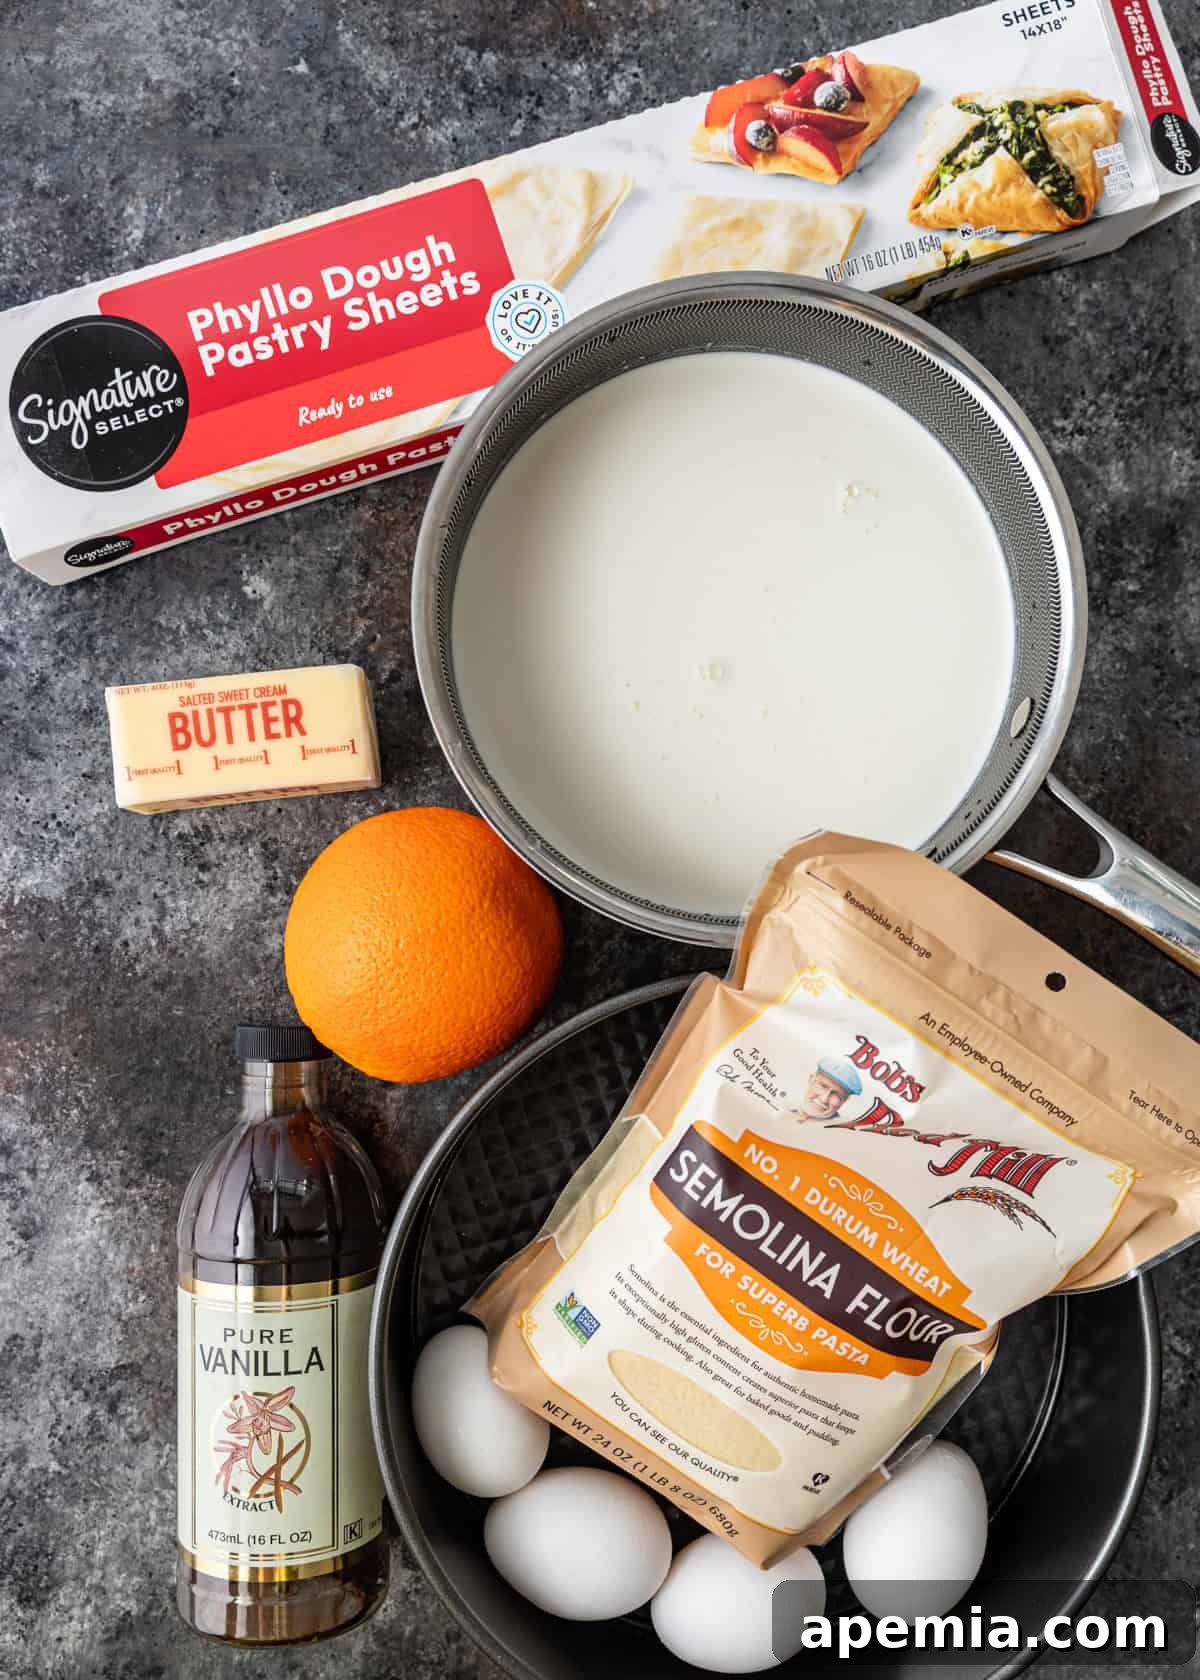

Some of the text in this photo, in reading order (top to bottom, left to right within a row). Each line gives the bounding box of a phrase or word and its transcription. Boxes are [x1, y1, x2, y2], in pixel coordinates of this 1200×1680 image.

[1002, 0, 1075, 27] SHEETS
[1123, 5, 1162, 107] Phyllo Dough
[1150, 55, 1172, 106] Pastry
[187, 235, 456, 342] Phyllo Dough
[824, 262, 844, 281] NET
[844, 257, 860, 277] WT
[861, 253, 874, 271] 16
[875, 249, 888, 267] OZ
[889, 245, 899, 265] (1
[900, 240, 918, 260] LB)
[197, 269, 480, 377] Pastry Sheets
[498, 288, 552, 319] LOVE IT
[501, 328, 513, 343] OR
[18, 364, 177, 450] Signature
[298, 385, 393, 427] Ready to use
[162, 499, 264, 535] Phyllo
[272, 462, 378, 501] Dough
[167, 698, 307, 751] BUTTER
[179, 684, 288, 707] SALTED SWEET CREAM
[843, 890, 932, 959] Resealable Package
[733, 1048, 755, 1071] Good
[749, 1047, 776, 1079] To Your
[846, 1034, 926, 1104] Bob's
[918, 1012, 1079, 1127] An Employee-Owned Company
[1128, 1089, 1150, 1109] Tear
[1150, 1104, 1173, 1126] Here
[1173, 1122, 1183, 1133] to
[668, 1149, 955, 1345] SEMOLINA FLOUR
[743, 1143, 952, 1298] NO. 1 DURUM WHEAT
[223, 1328, 293, 1345] PURE
[628, 1263, 658, 1297] Semolina
[659, 1293, 667, 1304] is
[666, 1301, 680, 1313] the
[680, 1310, 713, 1336] essential
[711, 1331, 750, 1364] ingredient
[750, 1360, 763, 1372] for
[763, 1371, 799, 1394] authentic
[800, 1388, 840, 1412] homemade
[694, 1241, 871, 1367] FOR SUPERB PASTA
[199, 1344, 325, 1377] VANILLA
[609, 1288, 618, 1300] its
[618, 1298, 638, 1320] shape
[637, 1316, 663, 1341] during
[695, 1360, 713, 1375] Also
[711, 1373, 733, 1389] great
[733, 1386, 746, 1398] for
[746, 1393, 771, 1411] baked
[767, 1407, 792, 1423] goods
[792, 1419, 809, 1431] and
[615, 1271, 856, 1435] Its exceptionally high gluten content creates superior pasta that keeps
[610, 1391, 630, 1413] YOU
[629, 1412, 651, 1432] CAN
[650, 1430, 668, 1445] SEE
[668, 1442, 690, 1460] OUR
[542, 1400, 739, 1538] NET WT 24 OZ (1 LB 8 OZ) 680g
[208, 1529, 312, 1547] 473mL (16 FL OZ)
